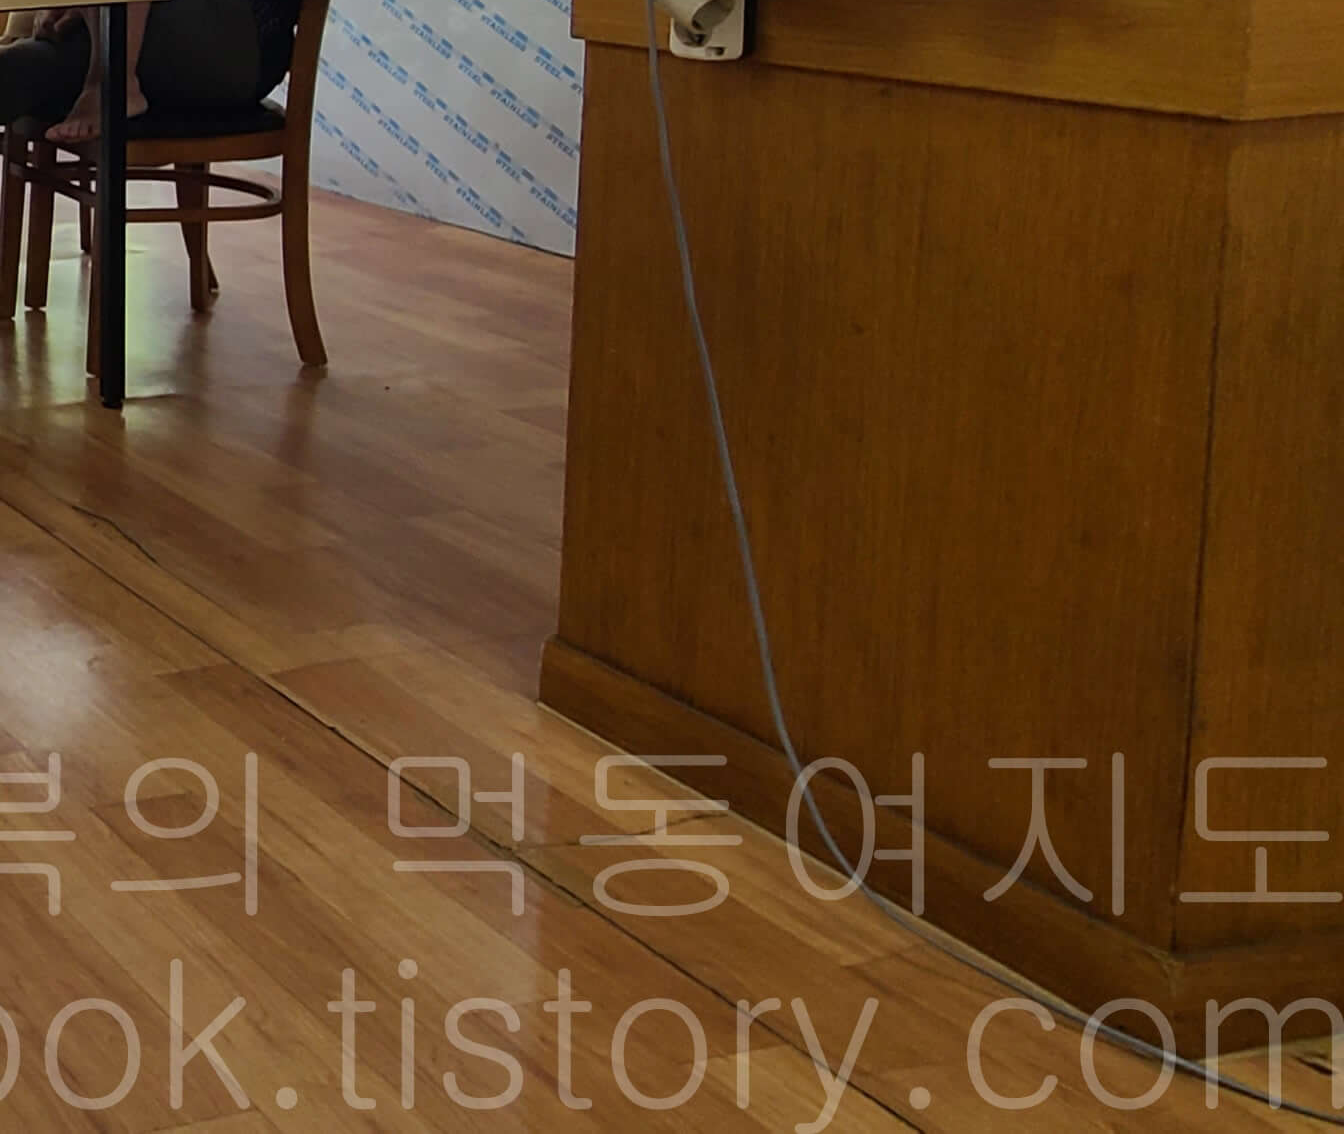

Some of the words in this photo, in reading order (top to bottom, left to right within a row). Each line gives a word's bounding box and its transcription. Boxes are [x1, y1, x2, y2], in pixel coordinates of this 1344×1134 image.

[480, 13, 527, 52] STAINLESS
[534, 55, 562, 81] STEEL
[409, 23, 451, 59] STAINLESS
[490, 88, 538, 129] STAINLESS
[545, 132, 577, 160] STEEL
[443, 113, 488, 154] STAINLESS
[455, 186, 502, 228] STAINLESS
